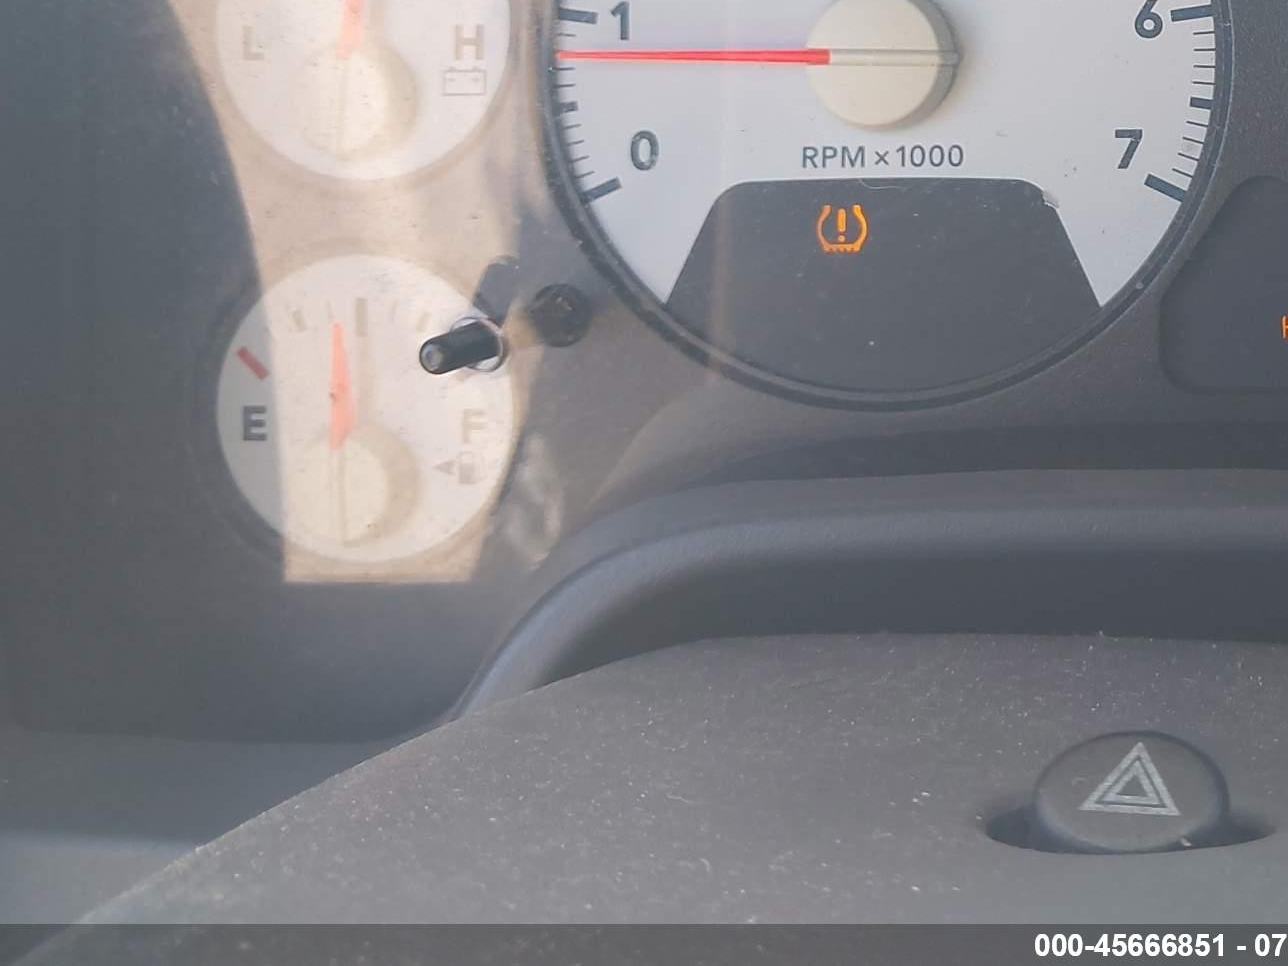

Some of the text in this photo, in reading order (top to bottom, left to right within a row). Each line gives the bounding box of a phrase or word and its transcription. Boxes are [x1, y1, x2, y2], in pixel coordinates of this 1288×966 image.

[610, 1, 630, 39] 1
[1134, 0, 1163, 38] 6
[243, 26, 264, 60] L
[454, 25, 484, 59] H
[630, 130, 659, 170] 0
[802, 146, 866, 169] RPM
[1114, 129, 1142, 168] 7
[243, 407, 267, 441] E
[463, 409, 486, 444] F
